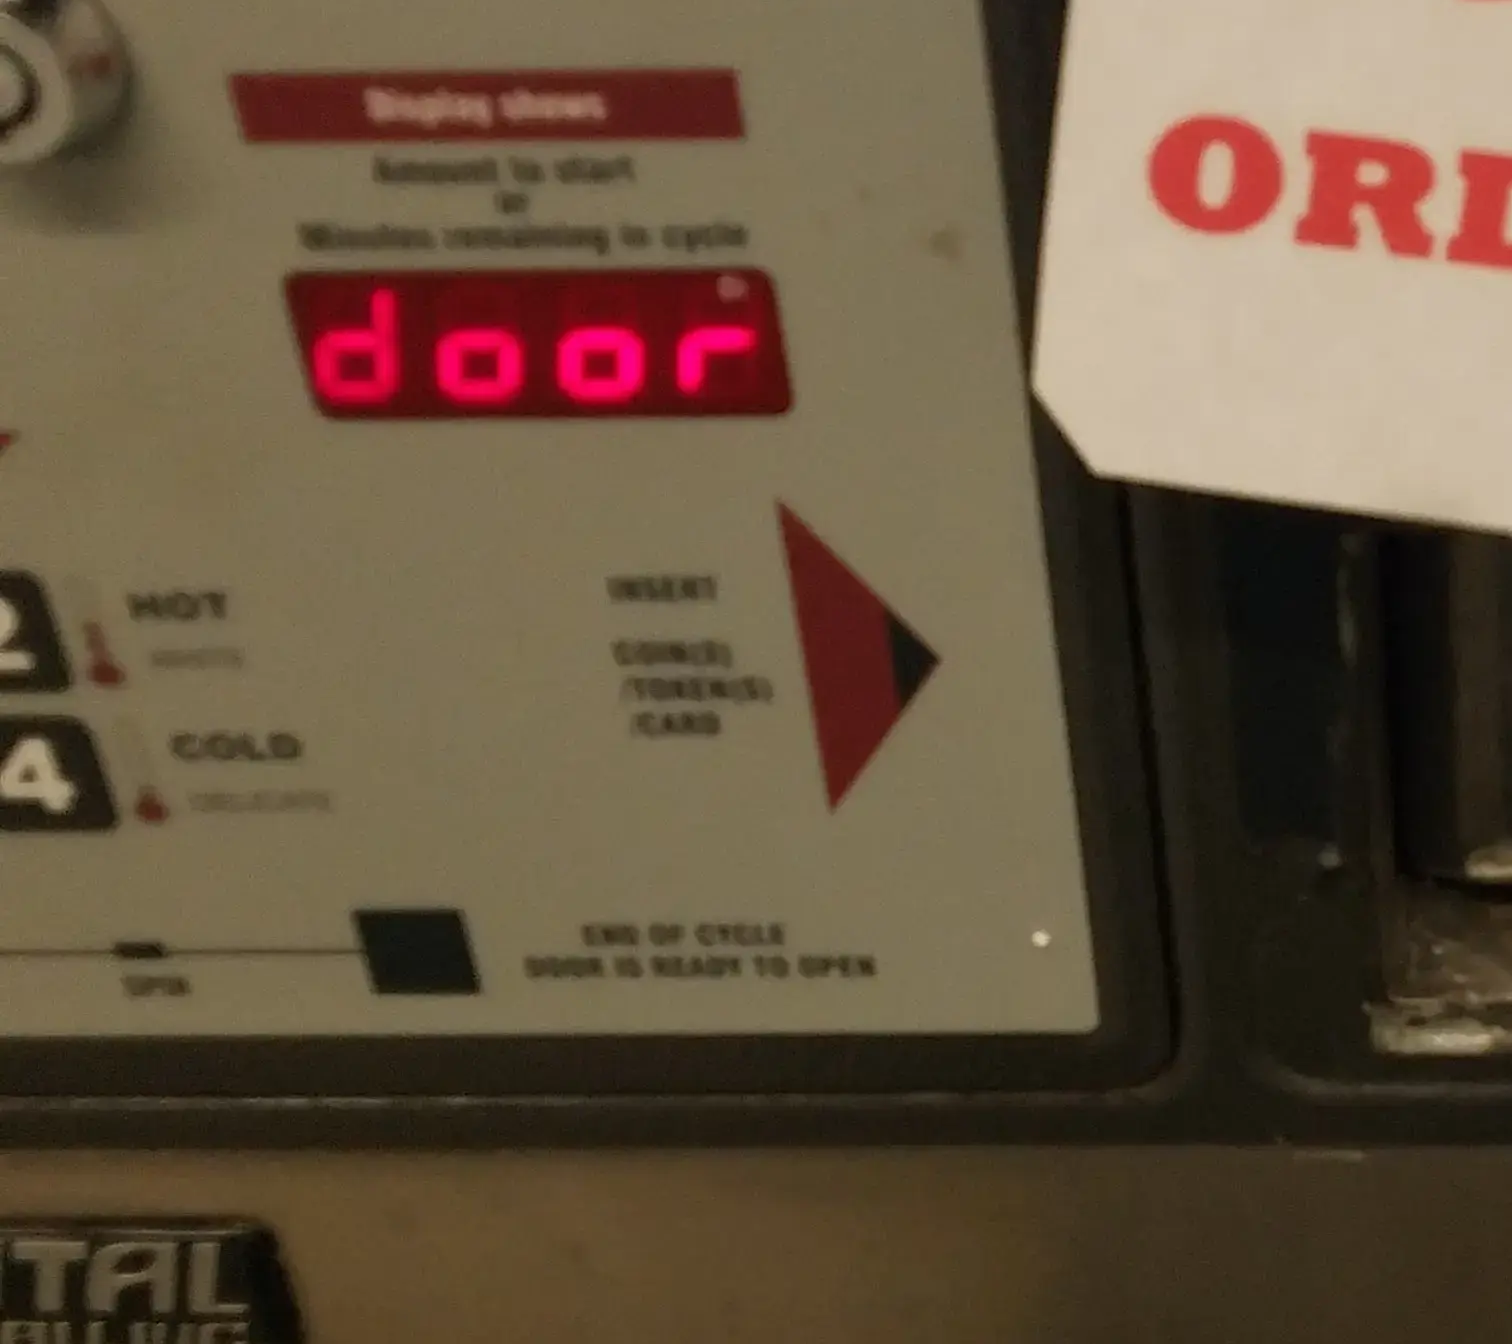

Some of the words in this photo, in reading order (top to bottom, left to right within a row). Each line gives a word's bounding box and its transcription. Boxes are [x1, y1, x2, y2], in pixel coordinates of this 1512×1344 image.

[312, 288, 757, 403] door
[606, 575, 718, 602] INSERT
[127, 592, 228, 621] HOT
[168, 729, 304, 761] COLD
[0, 737, 79, 814] 4
